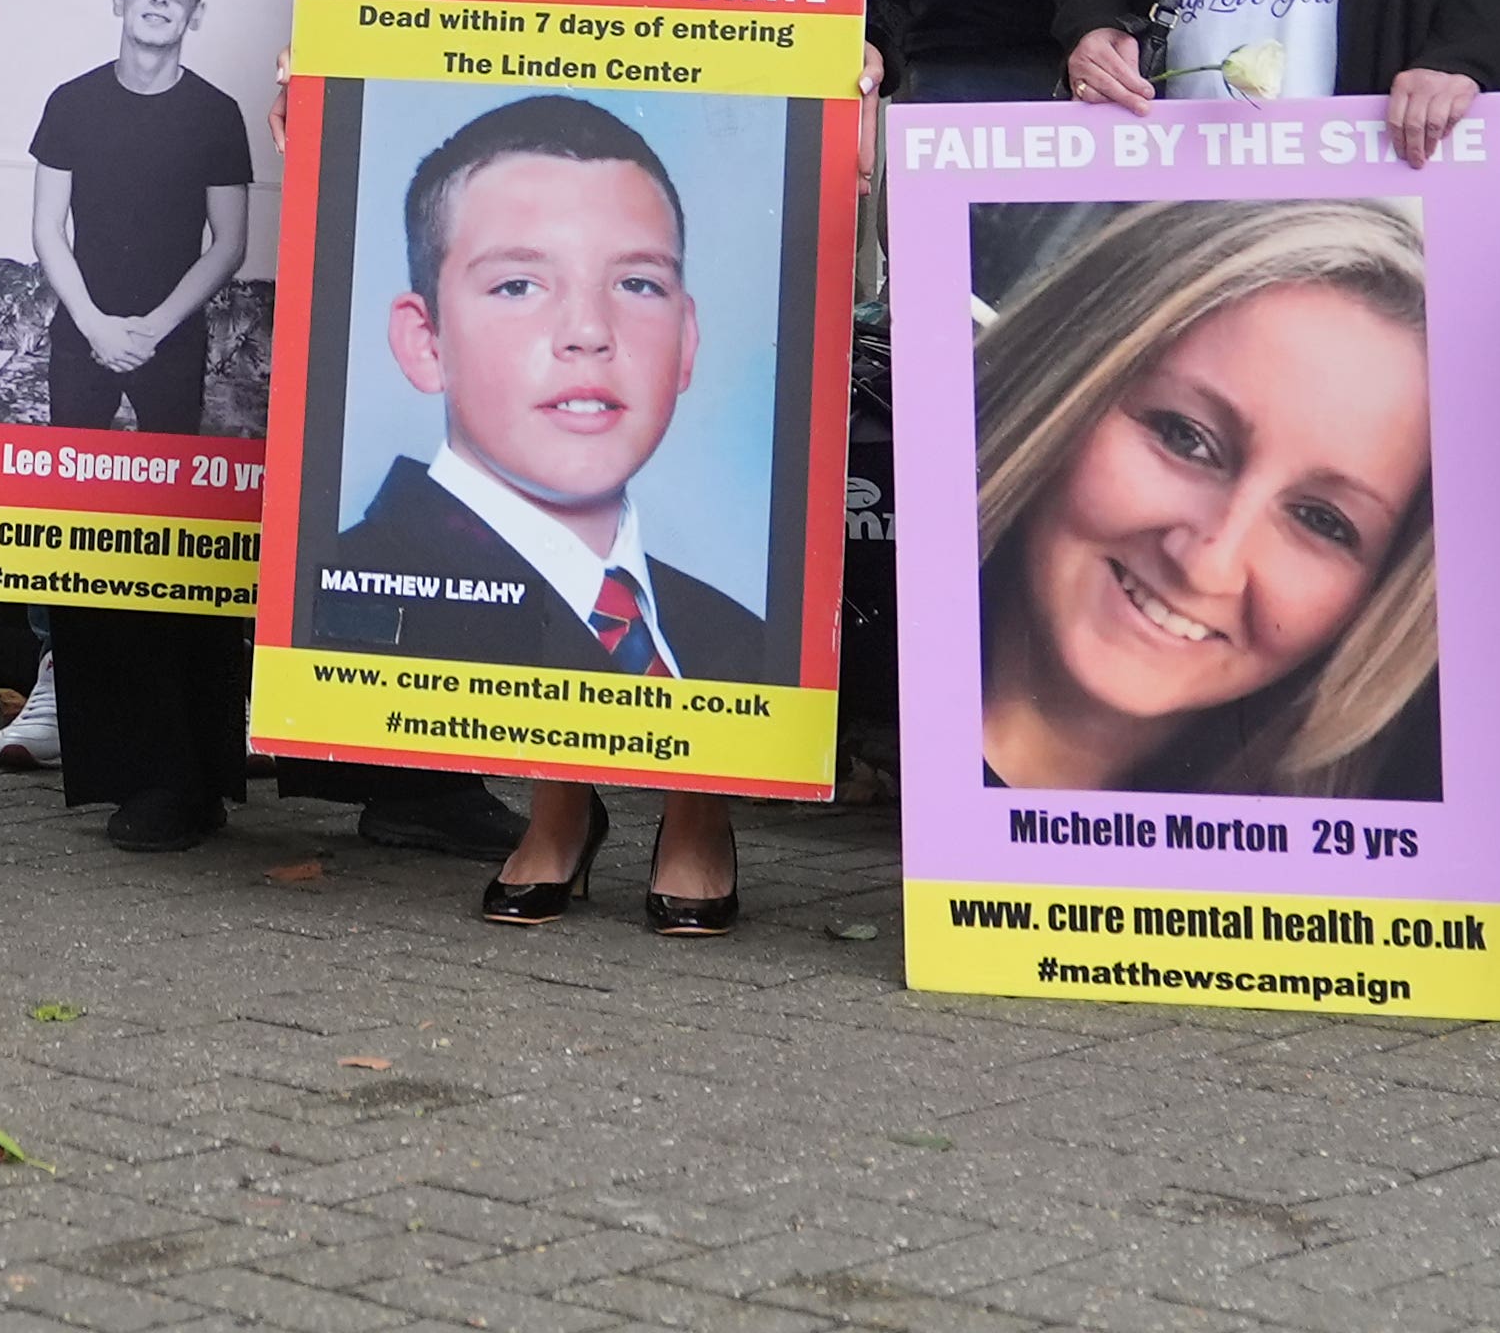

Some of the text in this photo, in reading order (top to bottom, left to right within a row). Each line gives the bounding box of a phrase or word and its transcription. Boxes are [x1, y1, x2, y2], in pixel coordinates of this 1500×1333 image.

[2, 442, 263, 491] Lee Spencer 20 yr
[320, 568, 525, 604] MATTHEW LEAHY
[1009, 808, 1418, 860] Michelle Morton 29 yrs
